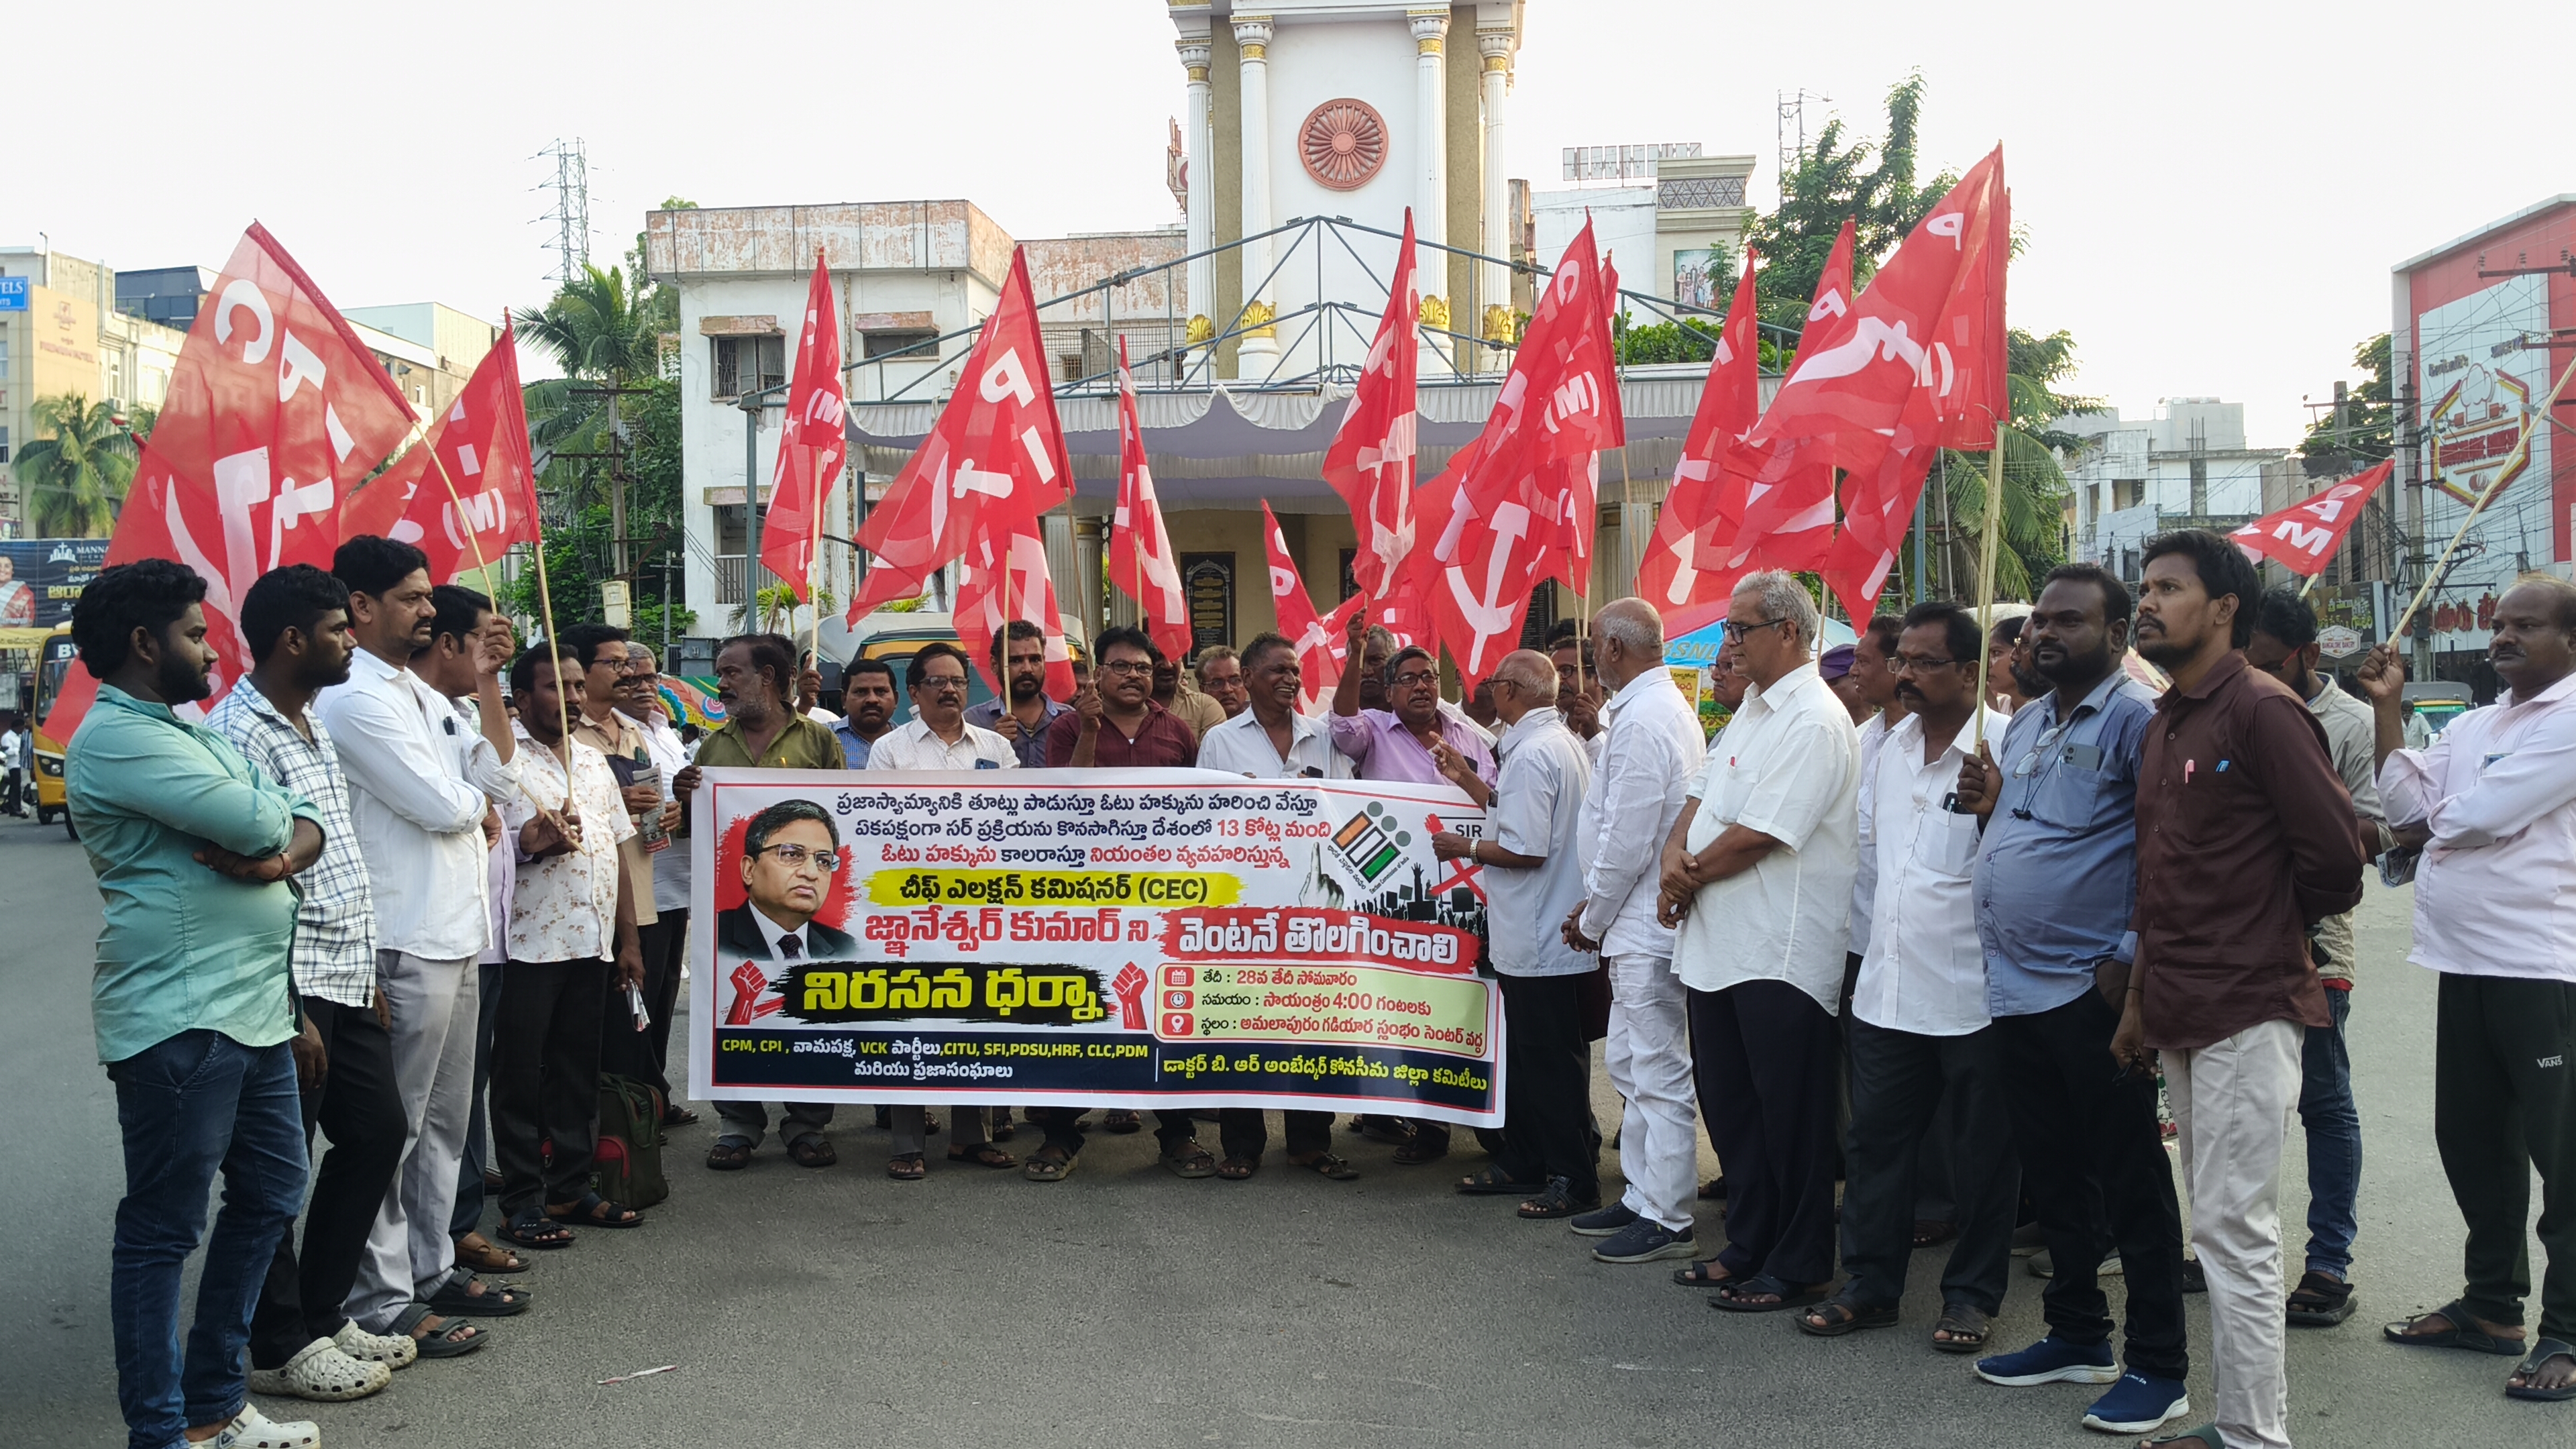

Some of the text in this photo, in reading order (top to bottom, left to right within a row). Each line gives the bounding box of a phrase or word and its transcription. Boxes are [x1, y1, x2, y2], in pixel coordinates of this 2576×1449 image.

[1100, 794, 1134, 811] ఓటు
[1140, 795, 1203, 815] హక్కును
[1208, 794, 1271, 811] హరించి
[855, 820, 941, 841] ఏకపక్షంగా
[947, 818, 973, 836] సర్
[977, 820, 1053, 842] ప్రక్రియను
[1152, 816, 1212, 837] దేశంలో
[1218, 819, 1239, 837] 13
[1244, 816, 1282, 843] కోట్ల
[1285, 820, 1332, 838] మంది
[1455, 824, 1482, 837] SIR
[881, 843, 920, 863] ఓటు
[925, 844, 997, 868] హక్కును
[1090, 844, 1172, 863] నియంతల
[900, 873, 1208, 904] చీఫ్ ఎలక్షన్ కమిషనర్ (CEC)
[1010, 908, 1122, 942] కుమార్
[1128, 919, 1149, 942] ని
[1179, 912, 1459, 965] వెంటనే తొలగించాలి
[804, 968, 1104, 1020] నిరసన ధర్నా
[1201, 993, 1251, 1006] సమయం
[1332, 992, 1373, 1010] 4:00
[1376, 996, 1432, 1016] గంటలకు
[1240, 1015, 1320, 1034] అమలాపురం
[1424, 1024, 1464, 1044] సెంటర్
[722, 1039, 756, 1053] CPM,
[860, 1041, 888, 1055] VCK
[855, 1061, 909, 1076] మరియు
[1163, 1054, 1208, 1079] డాక్టర్
[1234, 1054, 1260, 1072] ఆర్
[1330, 1055, 1389, 1078] కోనసీమ
[2537, 1055, 2563, 1068] VANS
